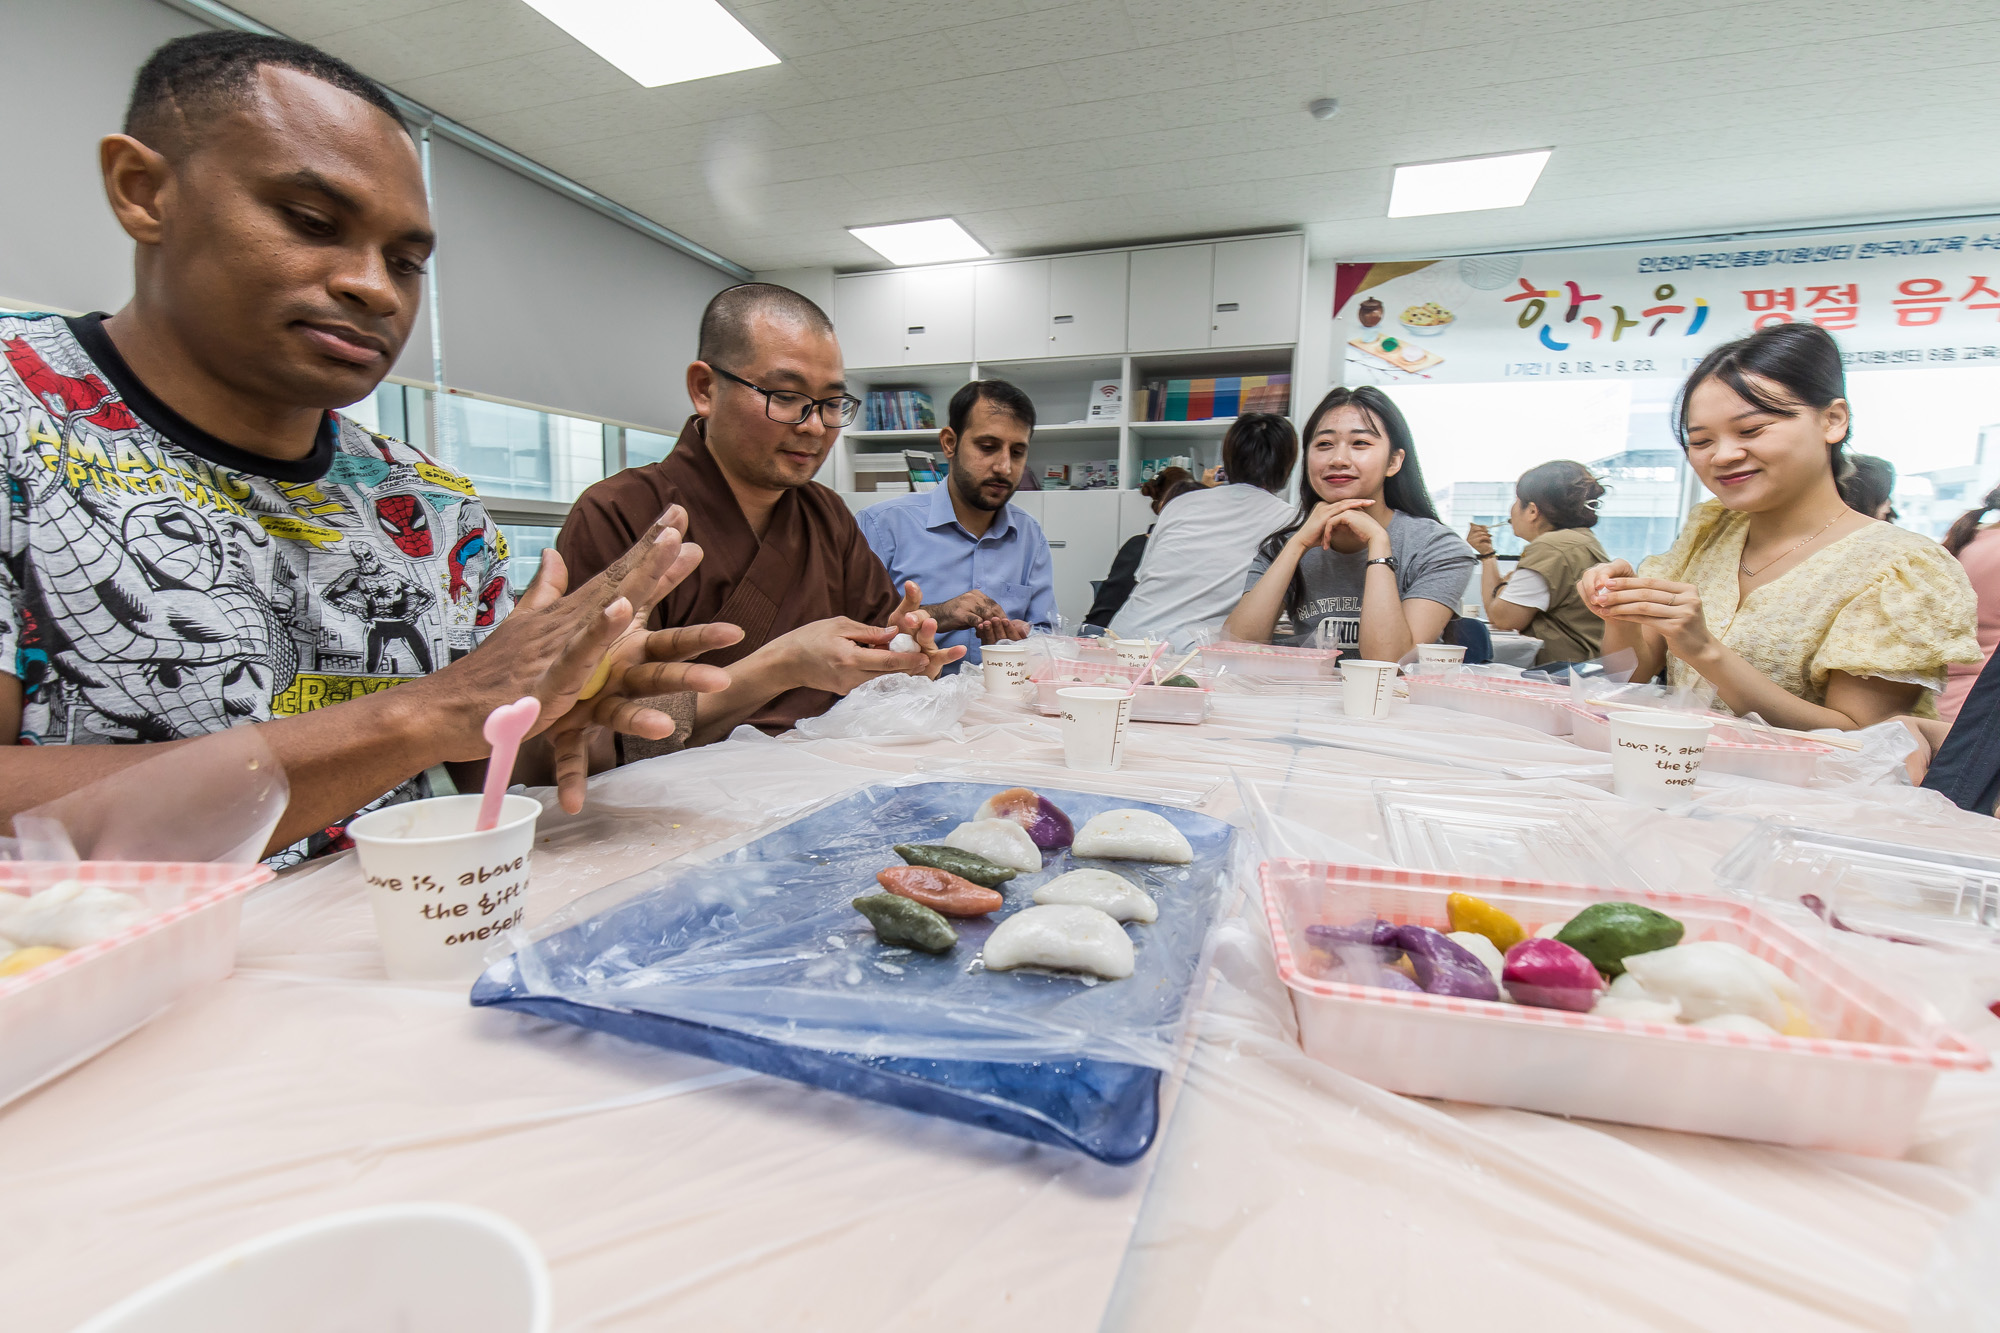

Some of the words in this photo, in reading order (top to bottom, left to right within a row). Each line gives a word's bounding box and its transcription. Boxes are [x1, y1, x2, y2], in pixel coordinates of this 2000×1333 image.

[1638, 244, 1856, 273] 인천외국인종합지원센터
[1857, 236, 1968, 259] 한국어교육
[1503, 278, 1709, 351] 한가위
[1741, 283, 1859, 331] 명절
[1297, 597, 1361, 620] MAYFIEL
[1325, 620, 1359, 643] UNIO
[1618, 738, 1649, 751] Love
[1655, 744, 1672, 756] is,
[1655, 760, 1681, 771] the
[412, 875, 445, 893] is,
[458, 855, 523, 887] above
[420, 902, 468, 920] the
[478, 881, 520, 916] gift
